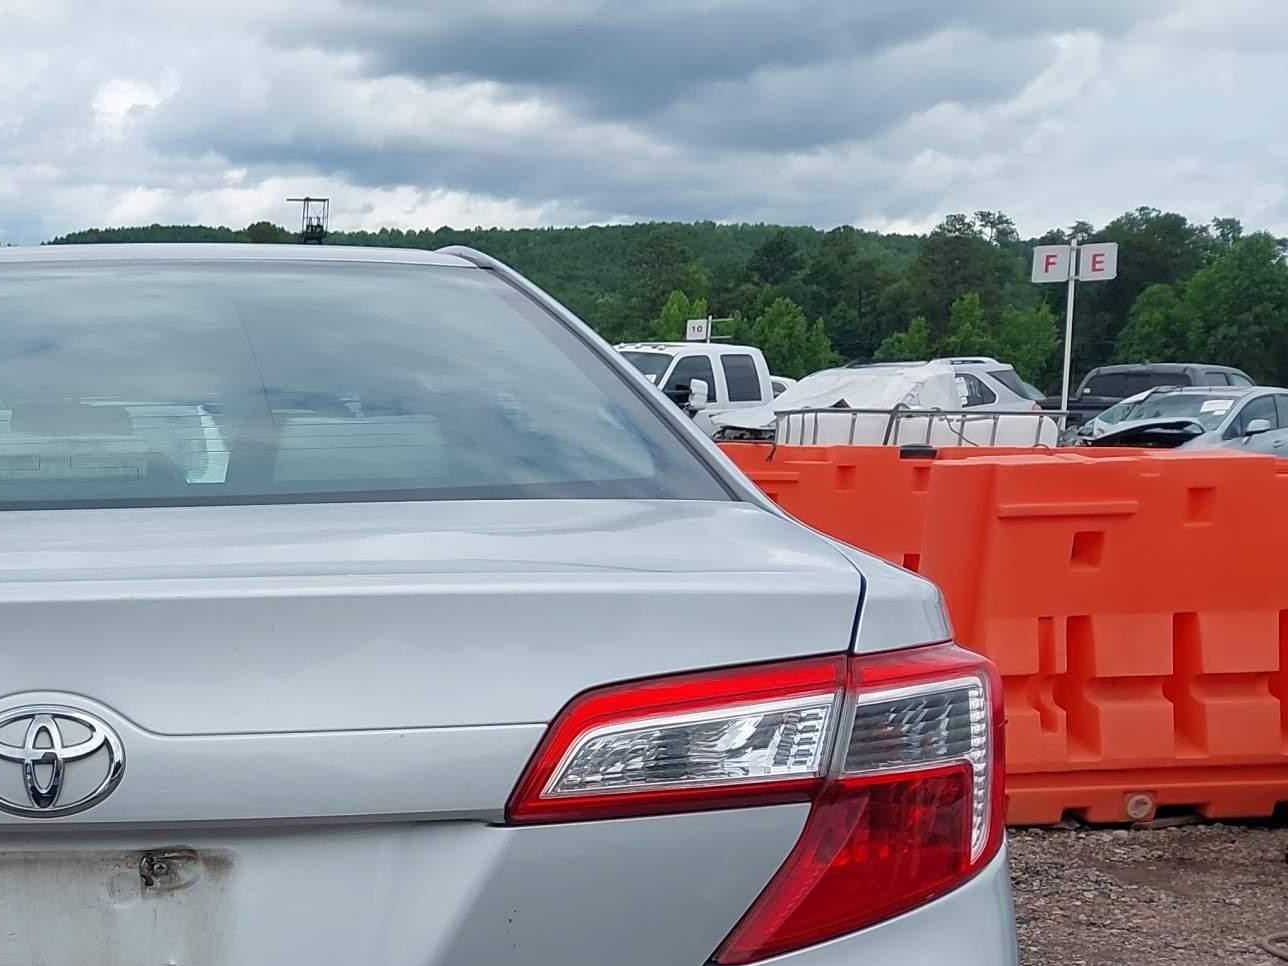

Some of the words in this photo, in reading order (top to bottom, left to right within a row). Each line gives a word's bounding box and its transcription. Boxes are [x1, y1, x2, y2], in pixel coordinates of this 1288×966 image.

[1044, 254, 1057, 273] F
[1091, 253, 1105, 272] E
[692, 325, 703, 333] 10
